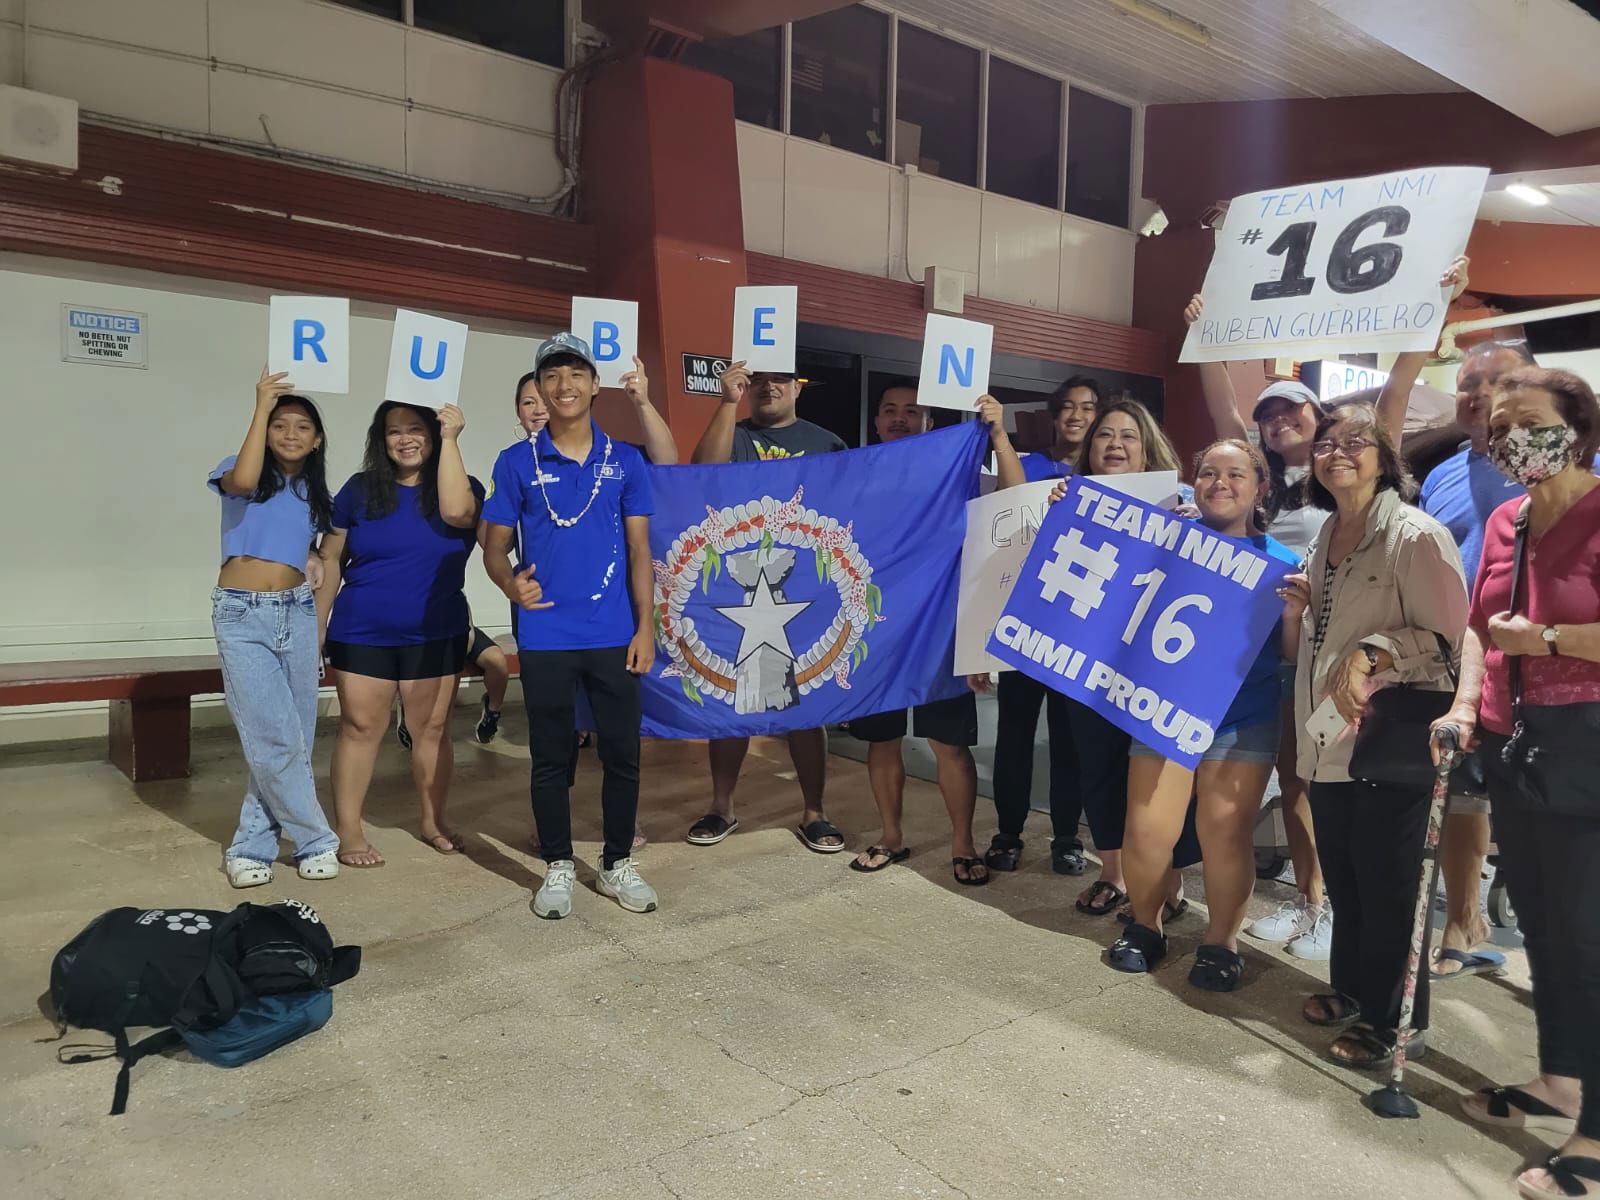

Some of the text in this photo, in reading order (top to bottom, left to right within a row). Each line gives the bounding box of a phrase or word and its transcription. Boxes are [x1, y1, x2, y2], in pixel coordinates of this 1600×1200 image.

[1260, 173, 1437, 219] TEAM NMI
[73, 312, 137, 331] NOTICE
[91, 332, 115, 341] BETEL
[293, 318, 328, 364] R
[593, 321, 621, 362] B
[752, 307, 776, 347] E
[1200, 302, 1435, 345] RUBEN GUERRERO
[82, 340, 128, 351] SPITTING OR
[88, 348, 122, 357] CHEWING
[410, 335, 448, 380] U
[938, 343, 974, 388] N
[687, 374, 723, 393] SMOKI
[692, 359, 708, 376] NO
[1344, 367, 1386, 393] POLI
[991, 502, 1049, 548] CN
[1077, 485, 1269, 592] TEAM NMI
[994, 614, 1087, 681] CNMI
[1084, 660, 1215, 754] PROUD
[284, 899, 319, 924] sfid
